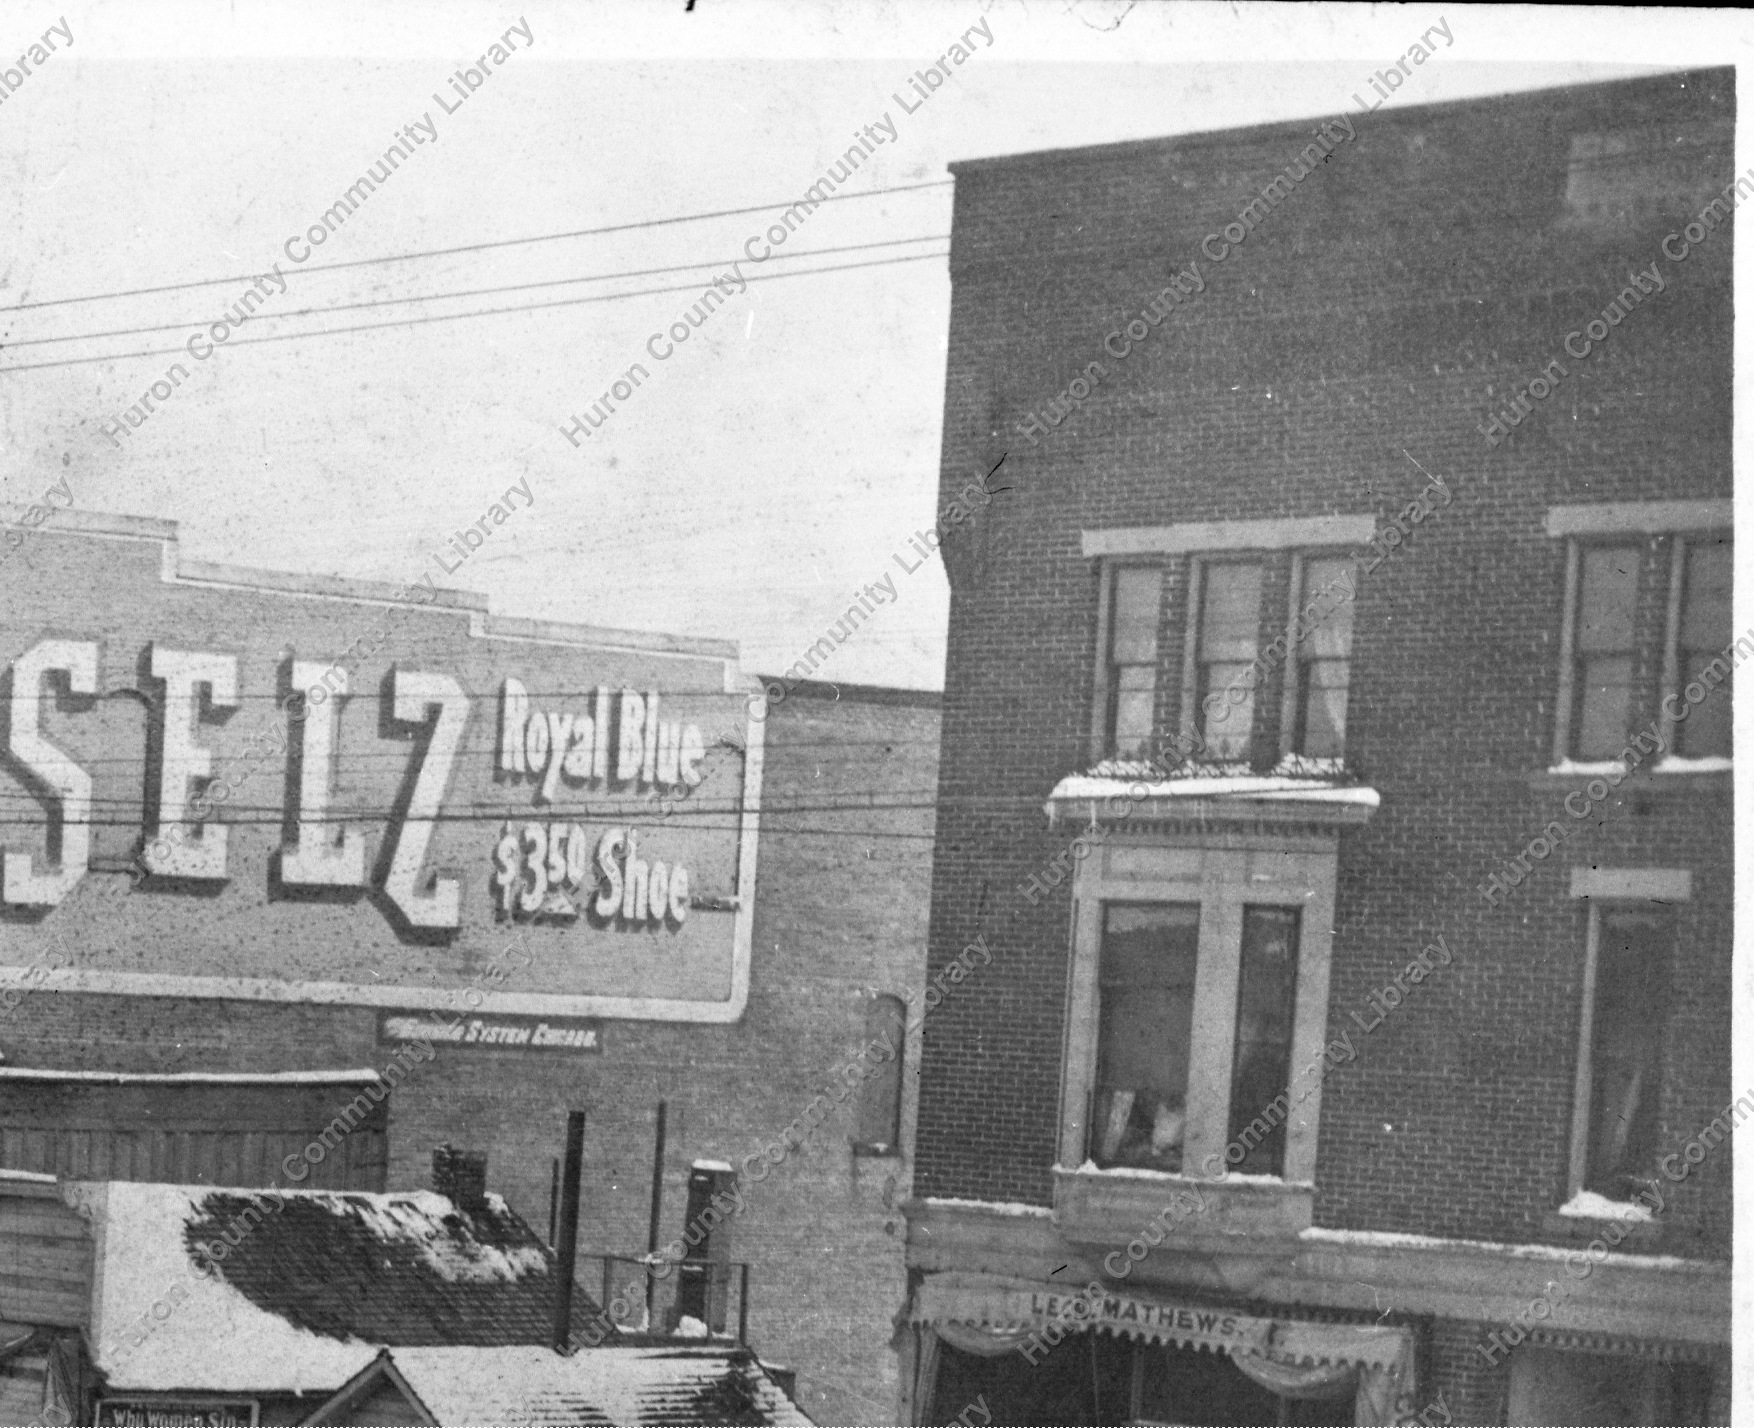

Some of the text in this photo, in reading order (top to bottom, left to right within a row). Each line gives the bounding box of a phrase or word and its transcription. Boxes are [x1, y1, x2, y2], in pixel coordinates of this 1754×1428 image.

[1, 639, 474, 930] SELZ
[500, 677, 706, 800] Royal Blue
[595, 827, 690, 923] Shoe
